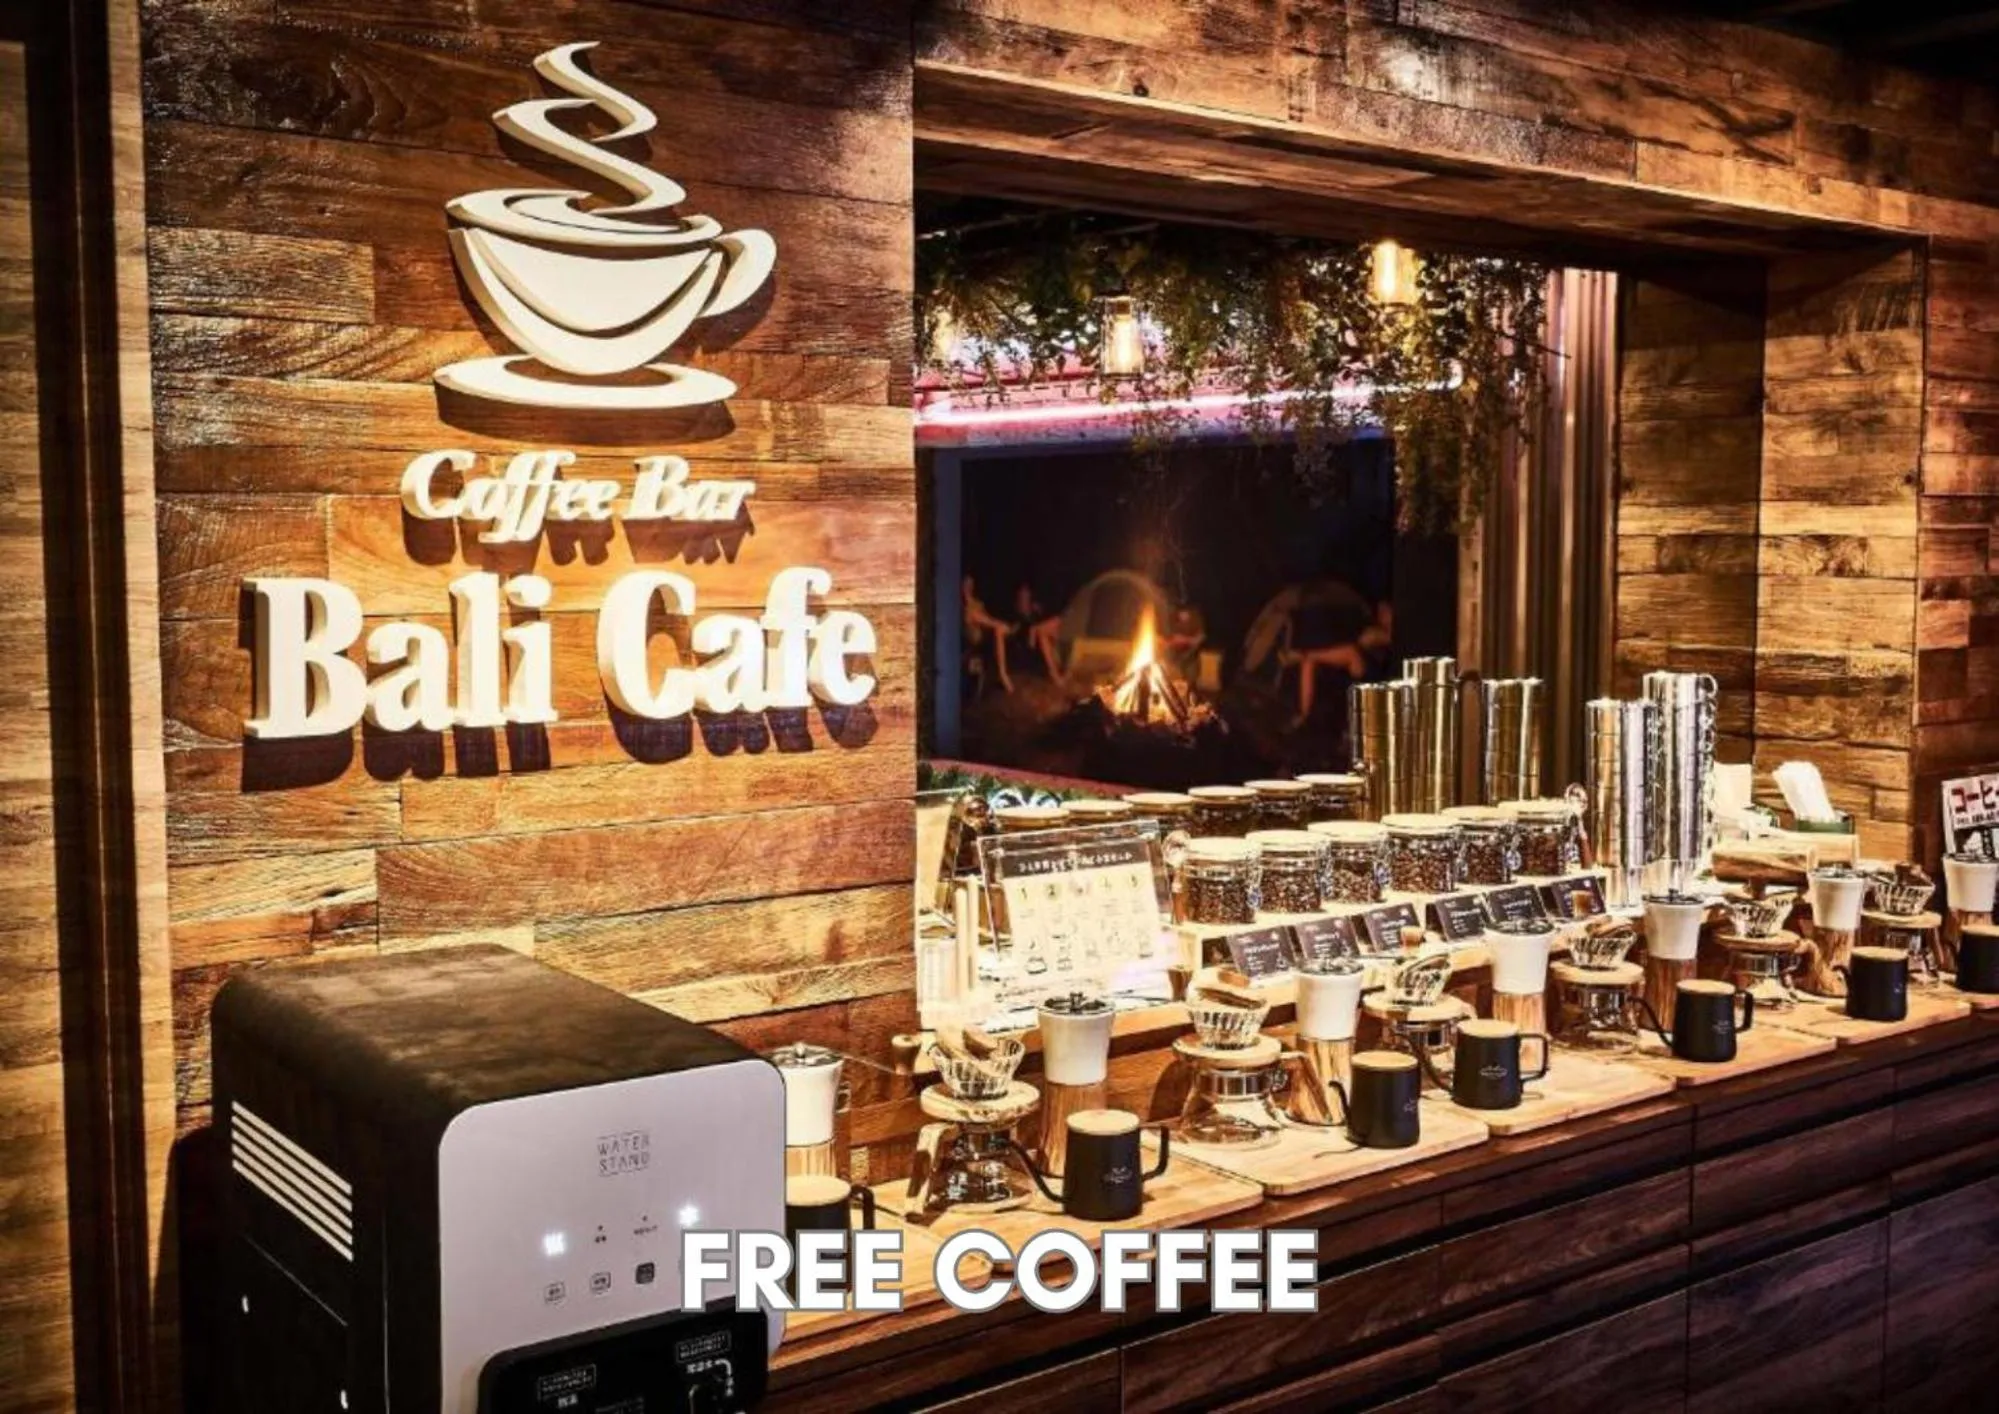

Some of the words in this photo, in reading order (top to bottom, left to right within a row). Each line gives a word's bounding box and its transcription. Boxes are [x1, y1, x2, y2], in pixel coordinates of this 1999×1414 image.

[401, 449, 621, 543] Coffee
[617, 455, 755, 521] Bar
[243, 572, 558, 739] Bali
[597, 567, 876, 720] Cafe
[597, 1134, 649, 1155] WATER
[599, 1152, 650, 1172] STAND
